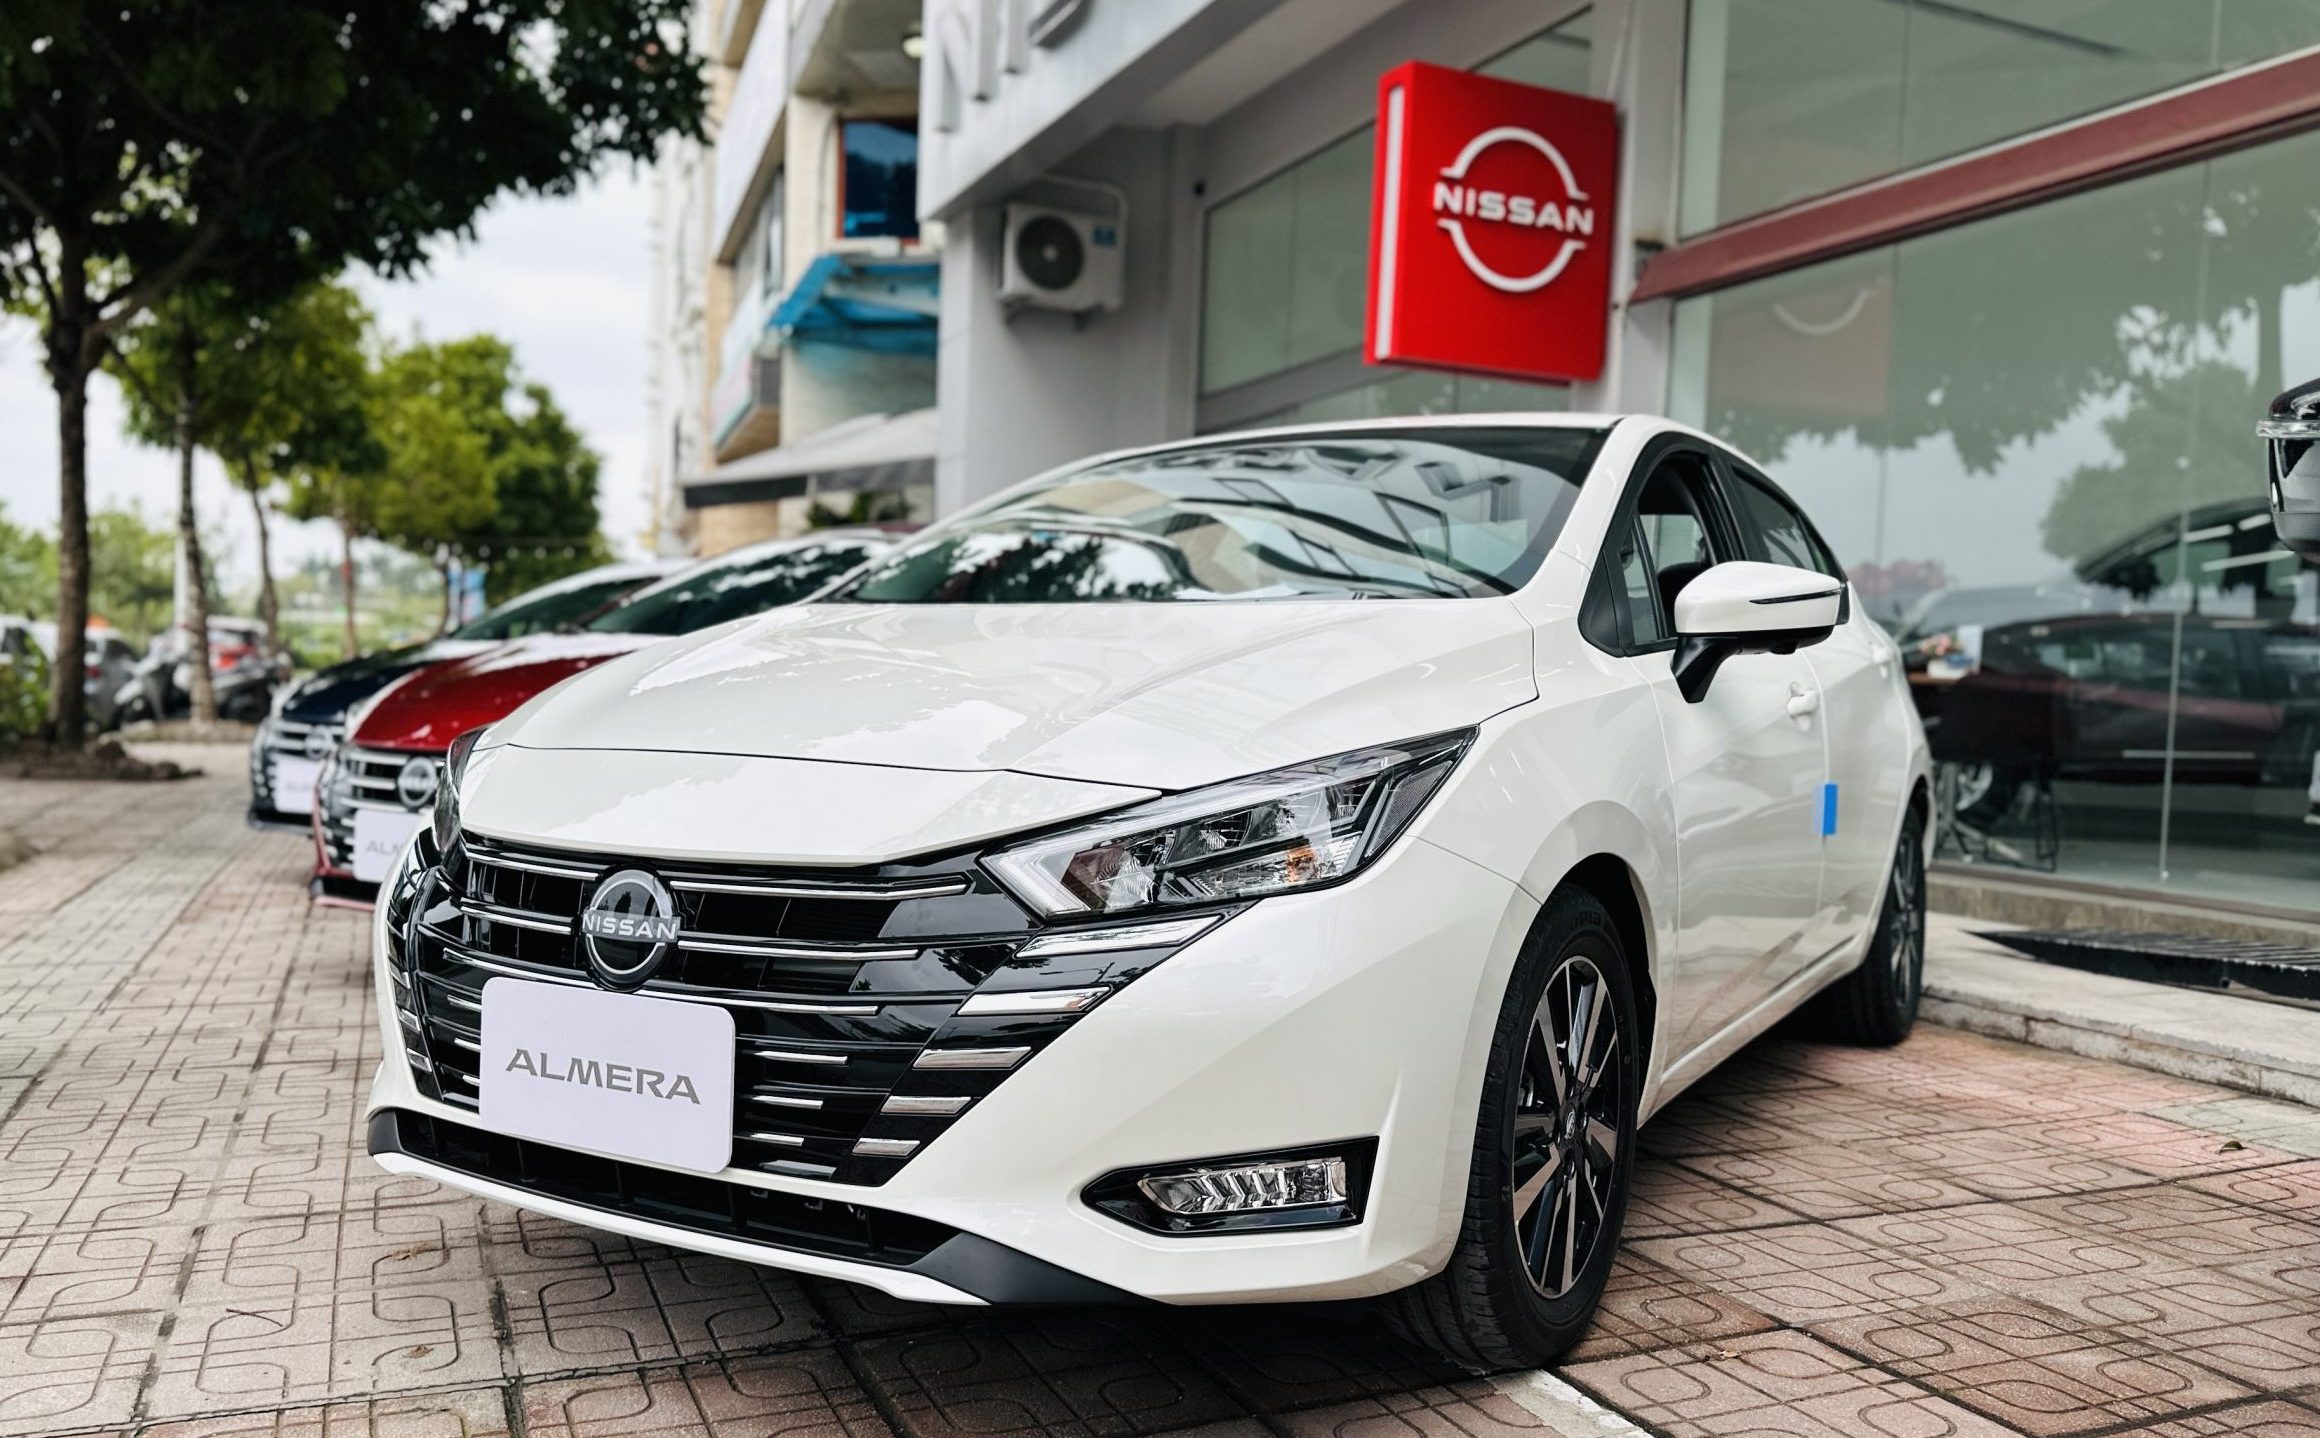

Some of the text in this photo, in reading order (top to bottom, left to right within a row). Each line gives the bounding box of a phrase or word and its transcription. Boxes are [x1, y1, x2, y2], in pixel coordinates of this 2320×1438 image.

[1432, 181, 1594, 236] NISSAN
[582, 912, 677, 940] NISSAN
[505, 1048, 702, 1105] ALMERA
